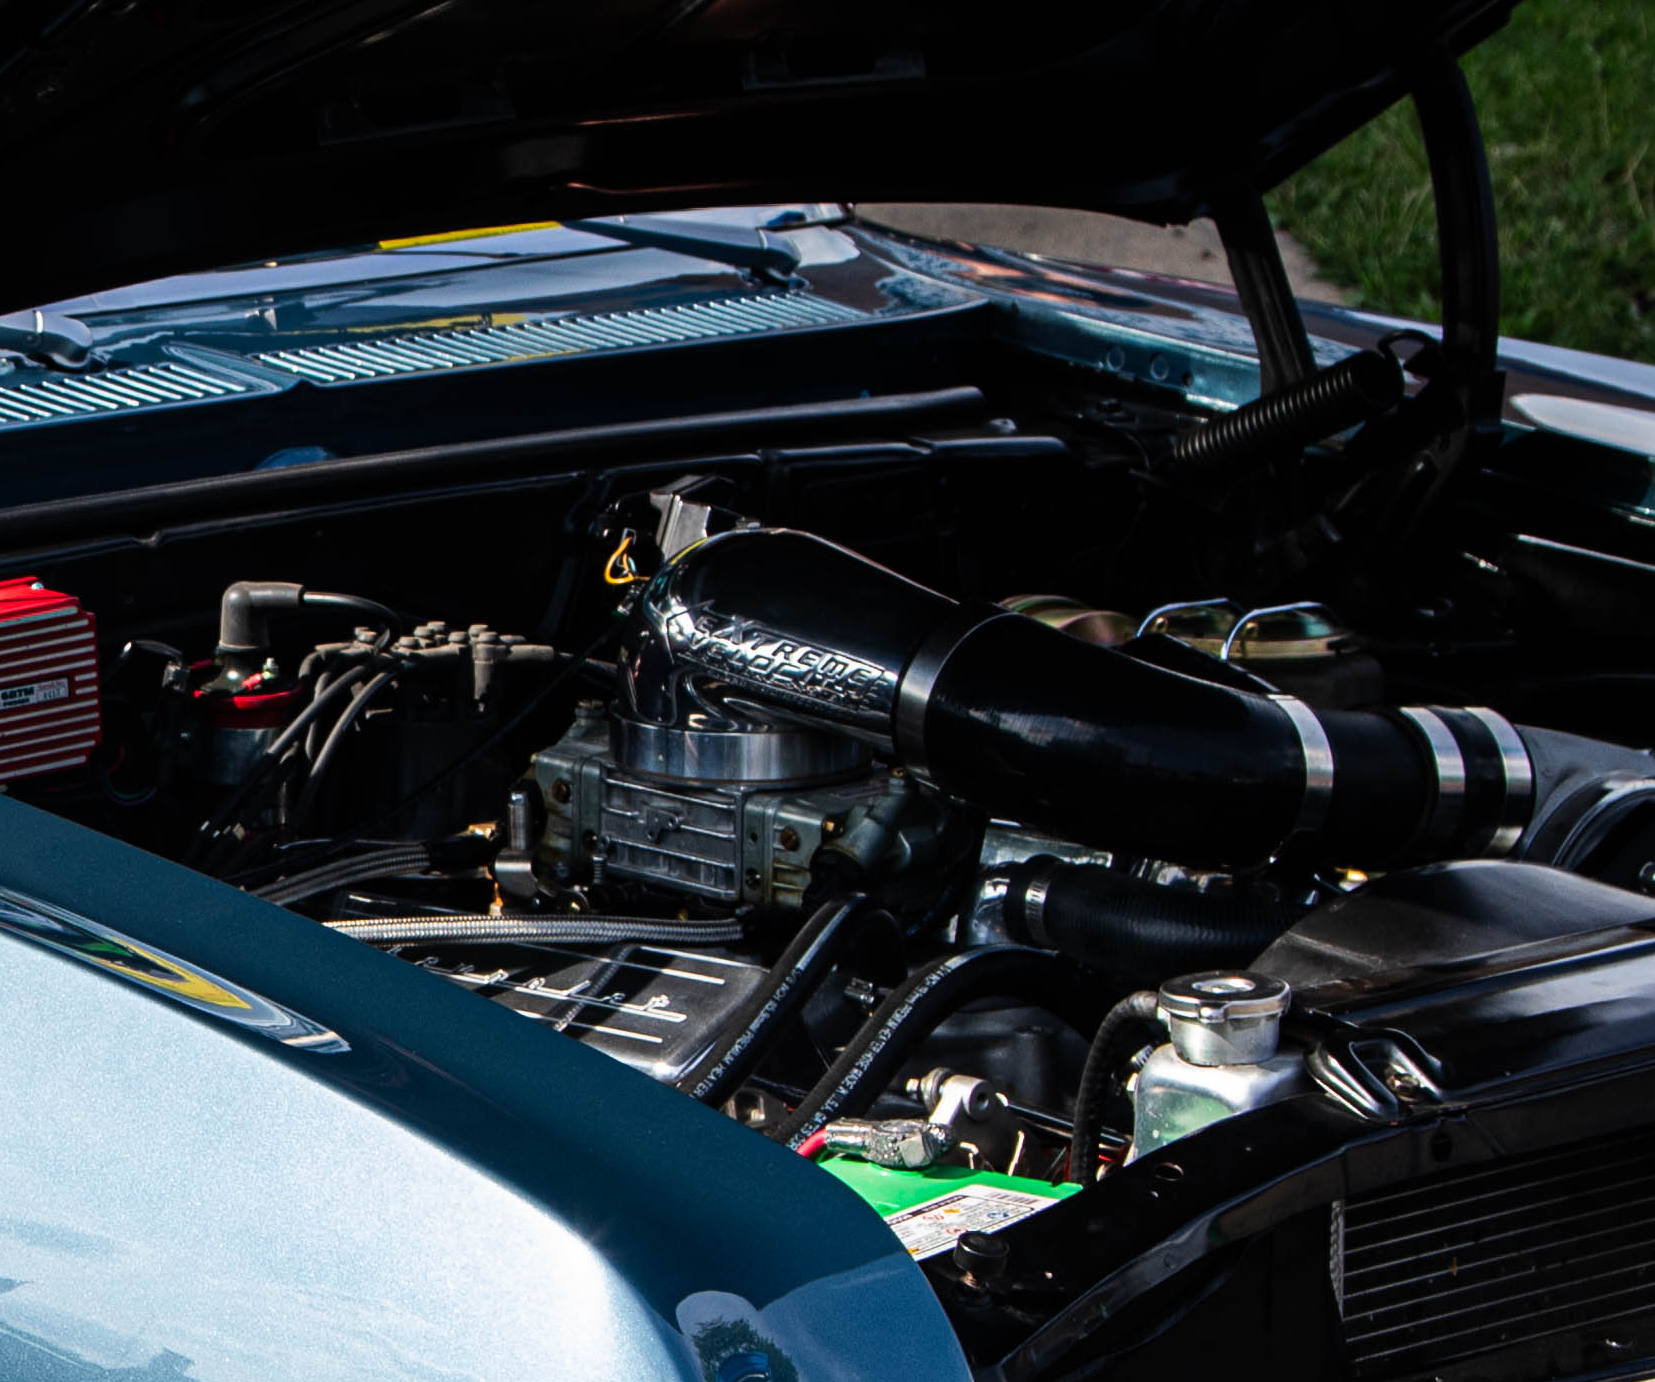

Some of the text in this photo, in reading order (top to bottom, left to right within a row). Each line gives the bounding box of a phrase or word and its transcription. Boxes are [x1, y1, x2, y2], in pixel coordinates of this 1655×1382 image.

[693, 614, 875, 687] EXTREME
[855, 1050, 874, 1073] HOSE
[693, 1062, 727, 1099] HEATER
